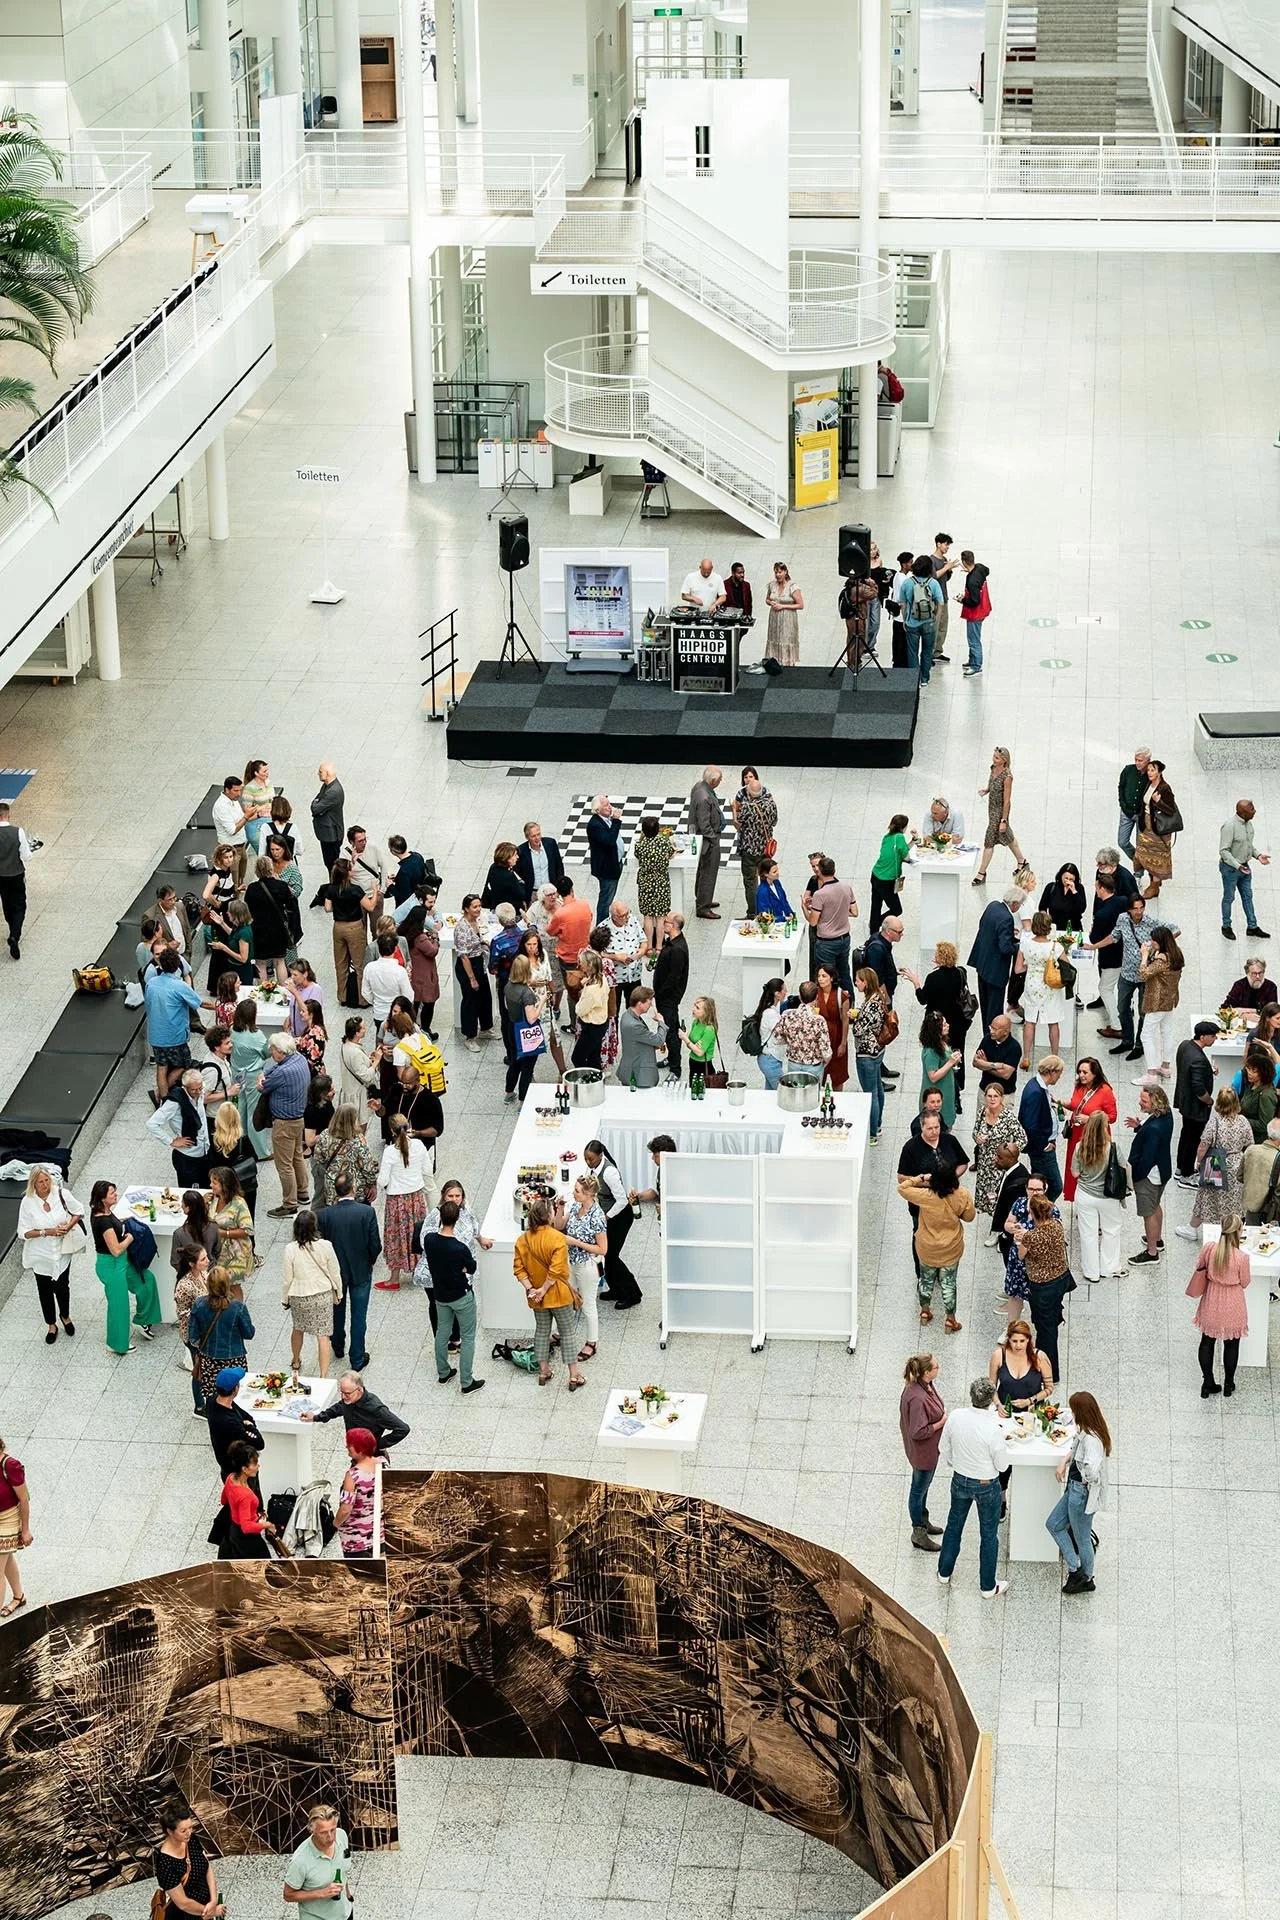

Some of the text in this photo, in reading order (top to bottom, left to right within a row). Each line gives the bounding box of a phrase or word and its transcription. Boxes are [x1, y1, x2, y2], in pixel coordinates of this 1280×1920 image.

[568, 274, 626, 285] Toiletten
[296, 470, 340, 482] Toiletten
[574, 586, 623, 596] ATRIUM
[680, 630, 725, 639] HAAGS
[680, 641, 725, 653] HIPHOP
[680, 654, 725, 663] CENTRUM
[522, 1027, 542, 1039] 1646
